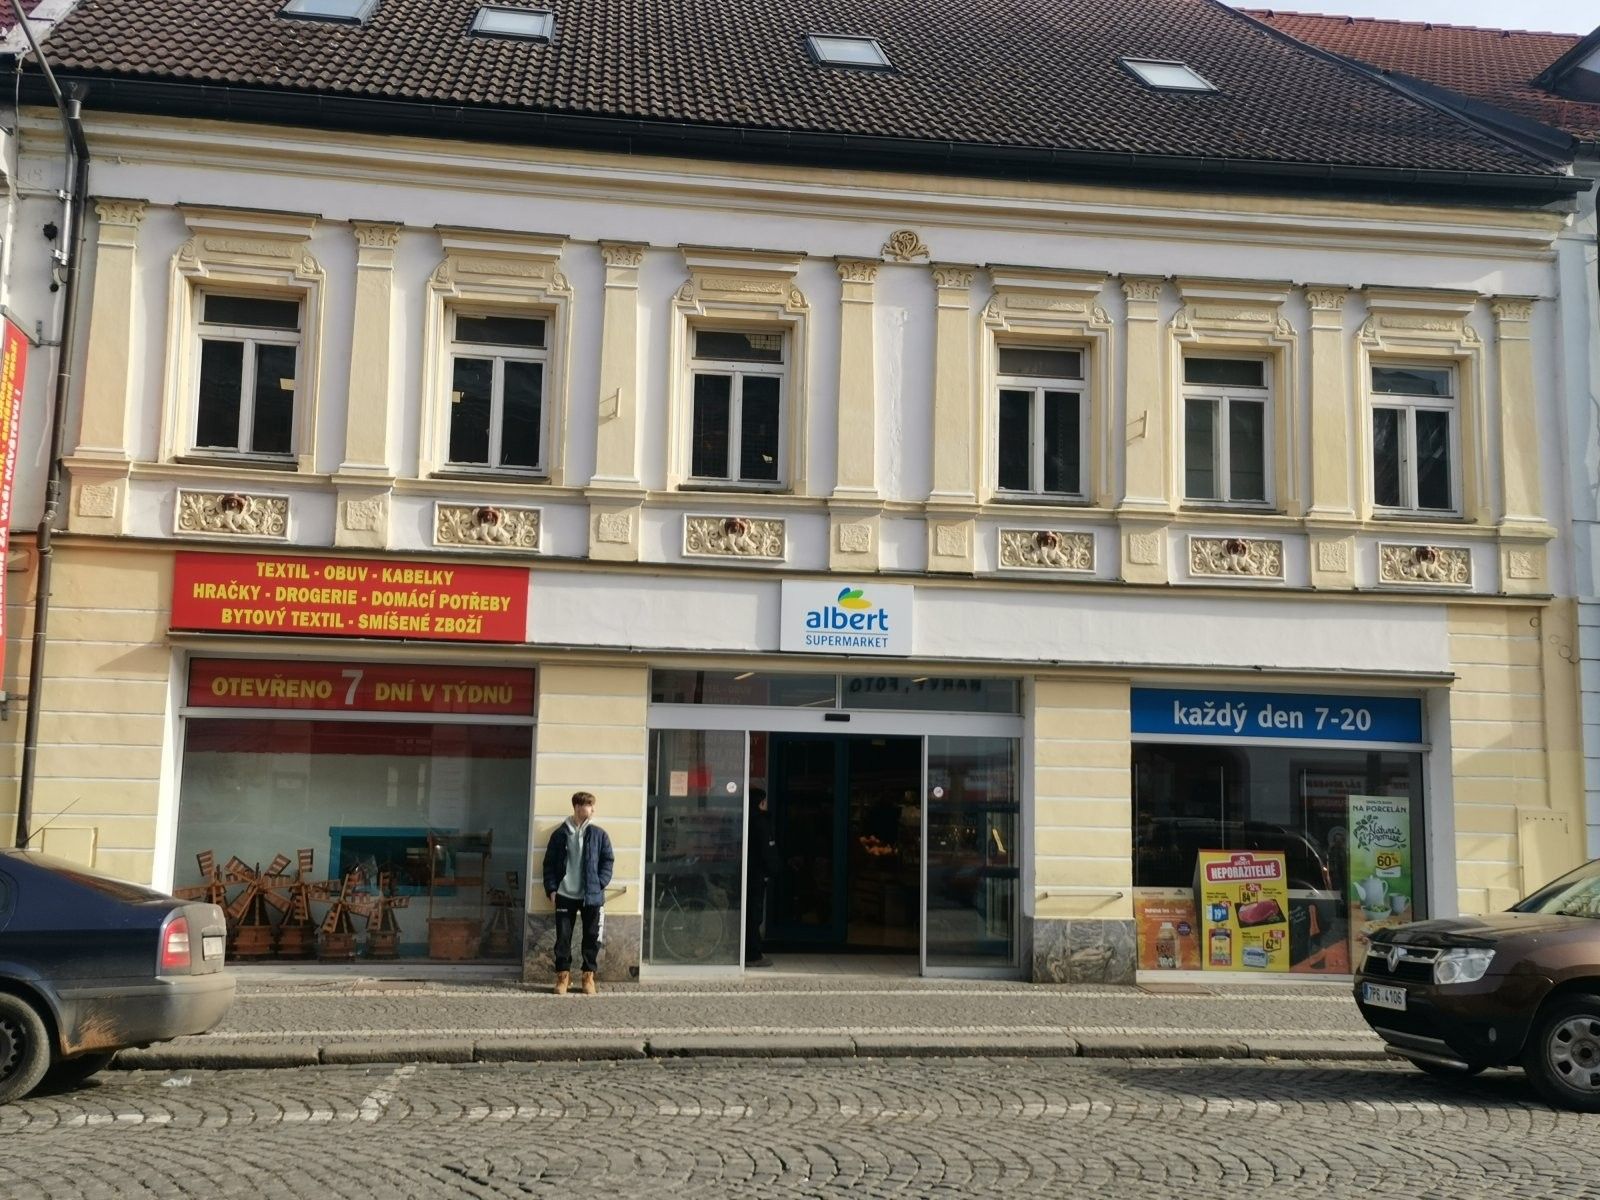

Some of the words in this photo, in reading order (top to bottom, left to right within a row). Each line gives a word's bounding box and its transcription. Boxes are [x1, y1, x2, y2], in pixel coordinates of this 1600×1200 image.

[256, 561, 310, 580] TEXTIL
[323, 565, 369, 583] OBUV
[381, 567, 455, 586] KABELKY
[192, 580, 262, 601] HRAČKY
[275, 586, 358, 605] DROGERIE
[371, 589, 436, 609] DOMÁCÍ
[438, 591, 512, 612] POTŘEBY
[220, 607, 287, 626] BYTOVÝ
[290, 611, 345, 628] TEXTIL
[357, 611, 431, 632] SMÍŠENÉ
[433, 614, 484, 634] ZBOŽÍ
[806, 606, 889, 633] albert
[805, 634, 889, 648] SUPERMARKET
[211, 674, 333, 699] OTEVŘENO
[341, 669, 364, 705] 7
[375, 680, 414, 702] DNÍ
[421, 684, 435, 702] V
[1173, 700, 1247, 733] každý
[1257, 704, 1304, 730] den
[1314, 707, 1372, 731] 7-20
[1366, 804, 1407, 813] PORCELÁN
[1211, 862, 1277, 880] NEPORAZITELNÉ
